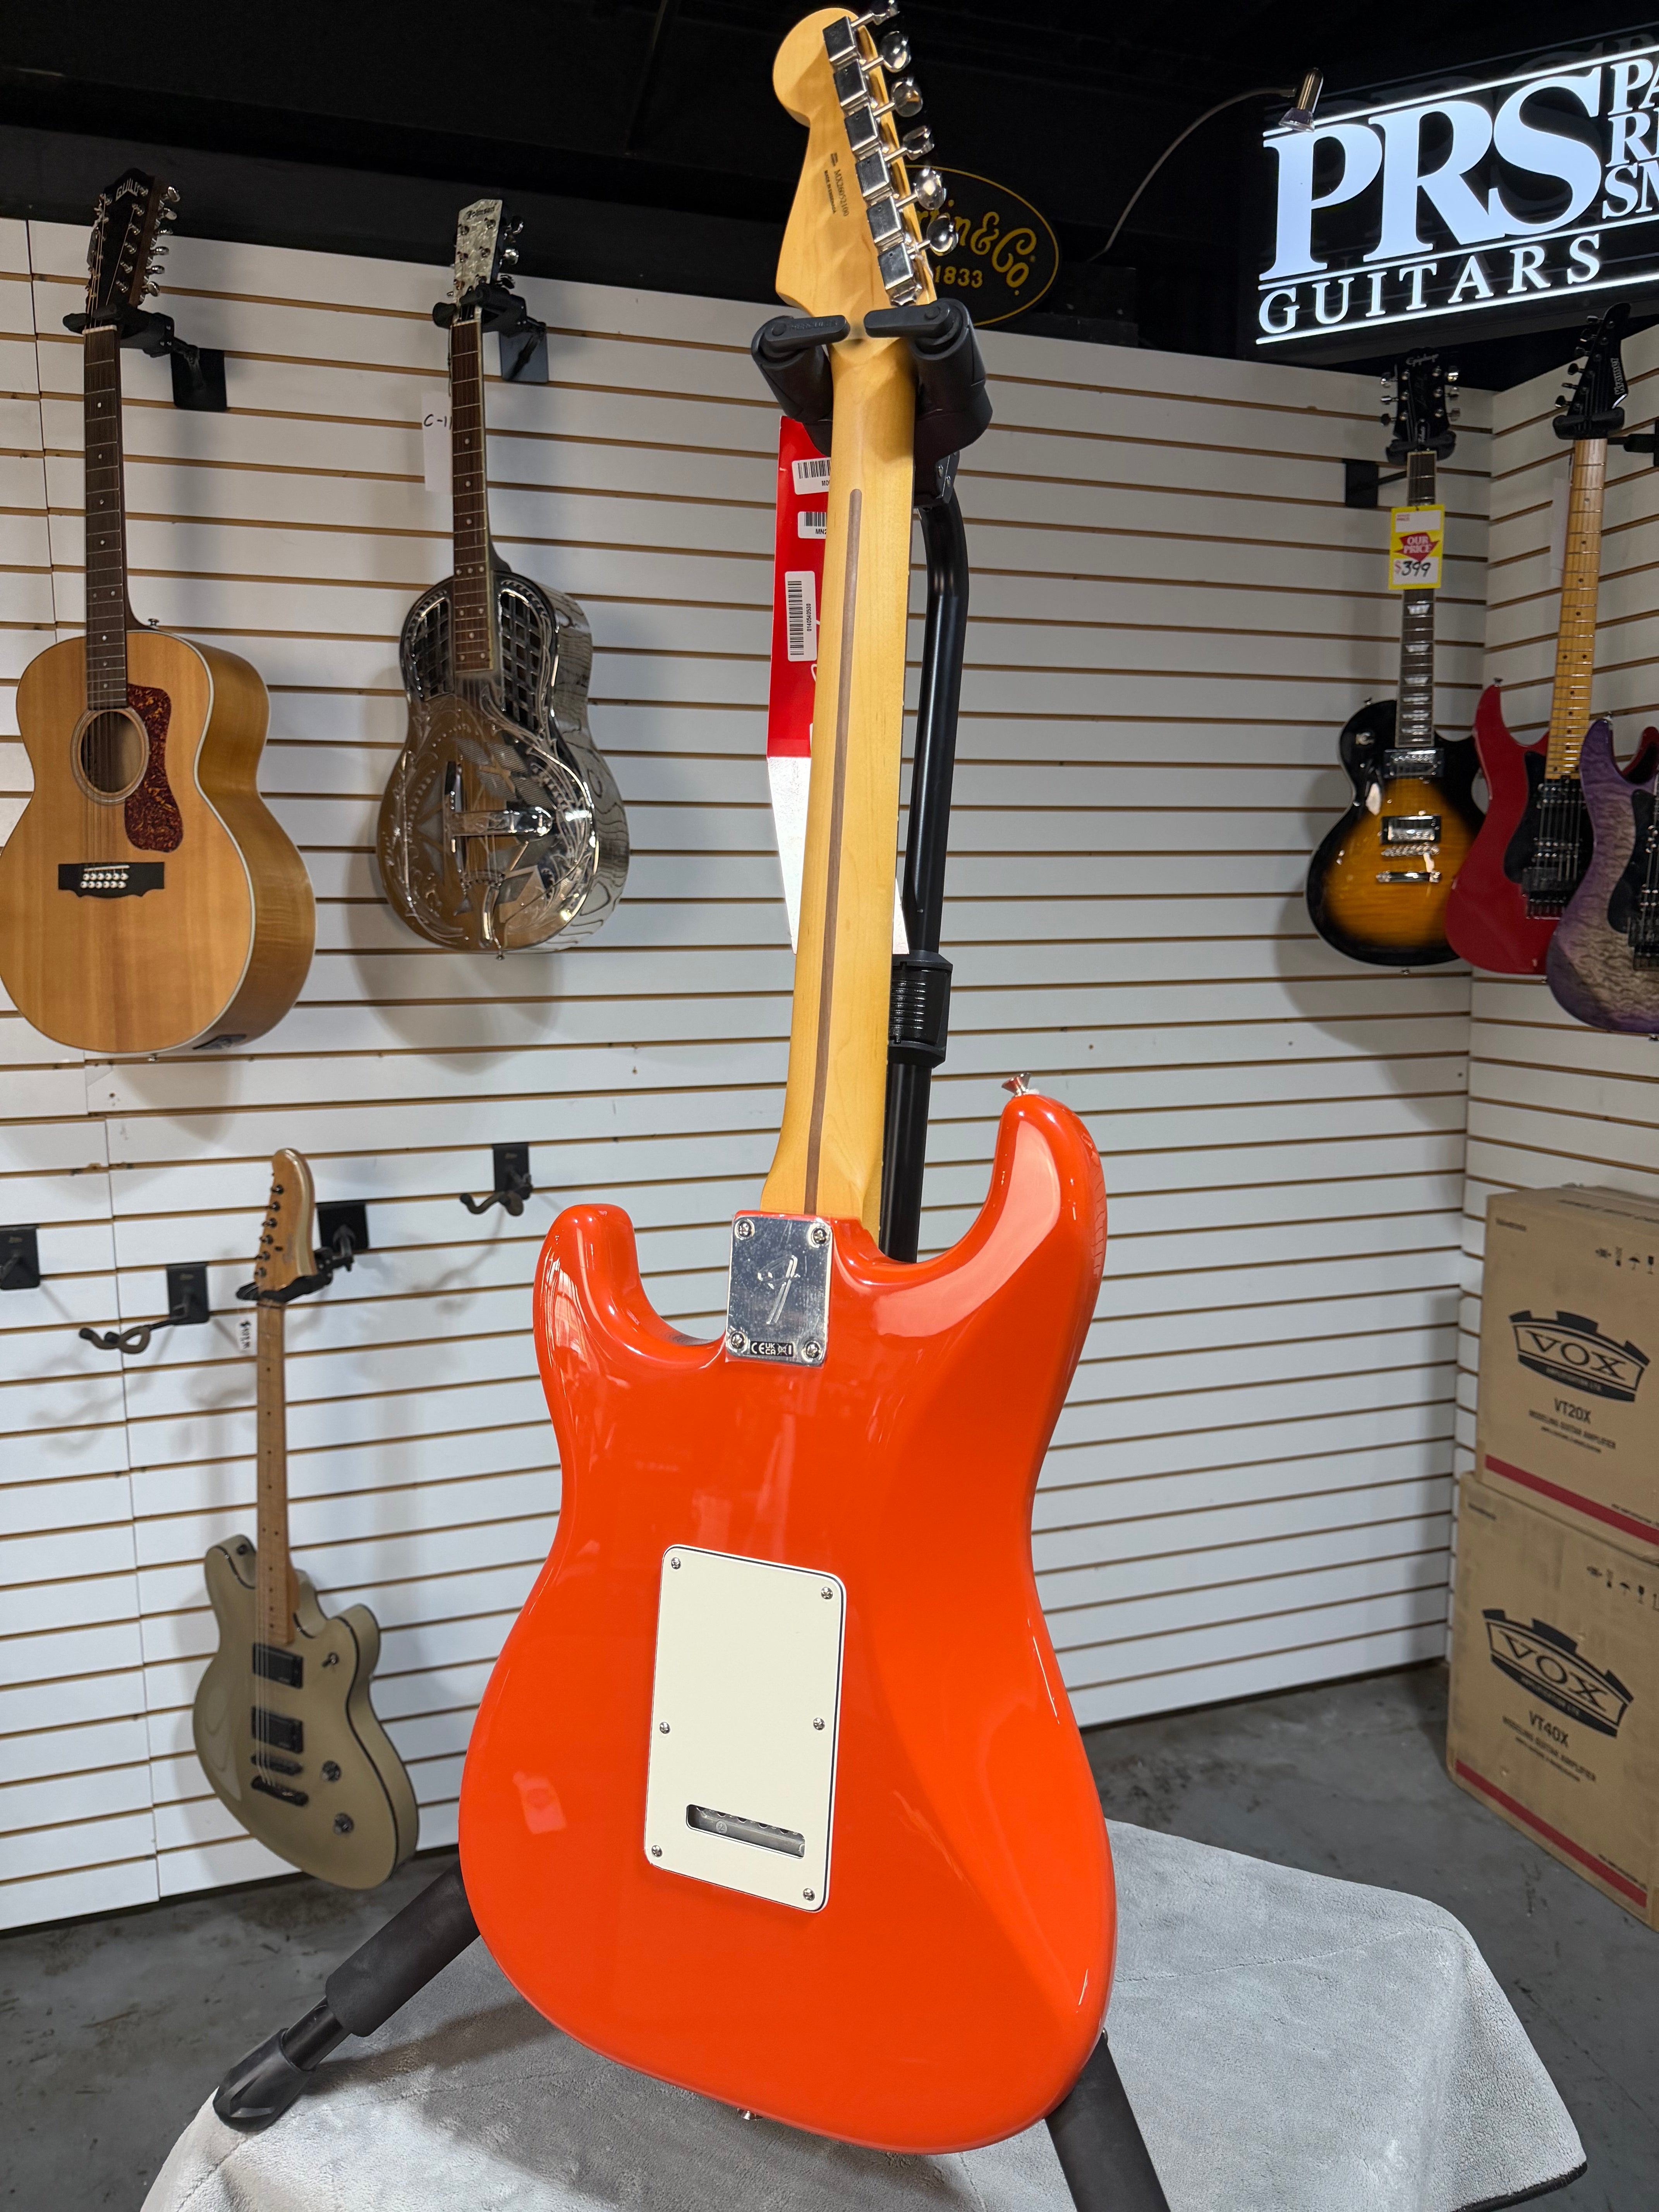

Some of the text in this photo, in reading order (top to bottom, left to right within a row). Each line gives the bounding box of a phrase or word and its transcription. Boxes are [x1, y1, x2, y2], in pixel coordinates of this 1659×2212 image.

[1606, 112, 1659, 167] R
[1259, 66, 1602, 281] PRS
[935, 265, 983, 288] 1833
[1259, 234, 1600, 334] GUITARS
[1610, 358, 1625, 395] Kramer
[1403, 544, 1432, 554] PRICE
[1407, 536, 1429, 544] OUR
[752, 1342, 764, 1354] CE
[1526, 1331, 1626, 1381] VOX
[1554, 1397, 1591, 1424] VT20X
[1499, 1628, 1607, 1712] VOX
[1529, 1710, 1568, 1748] VT40X
